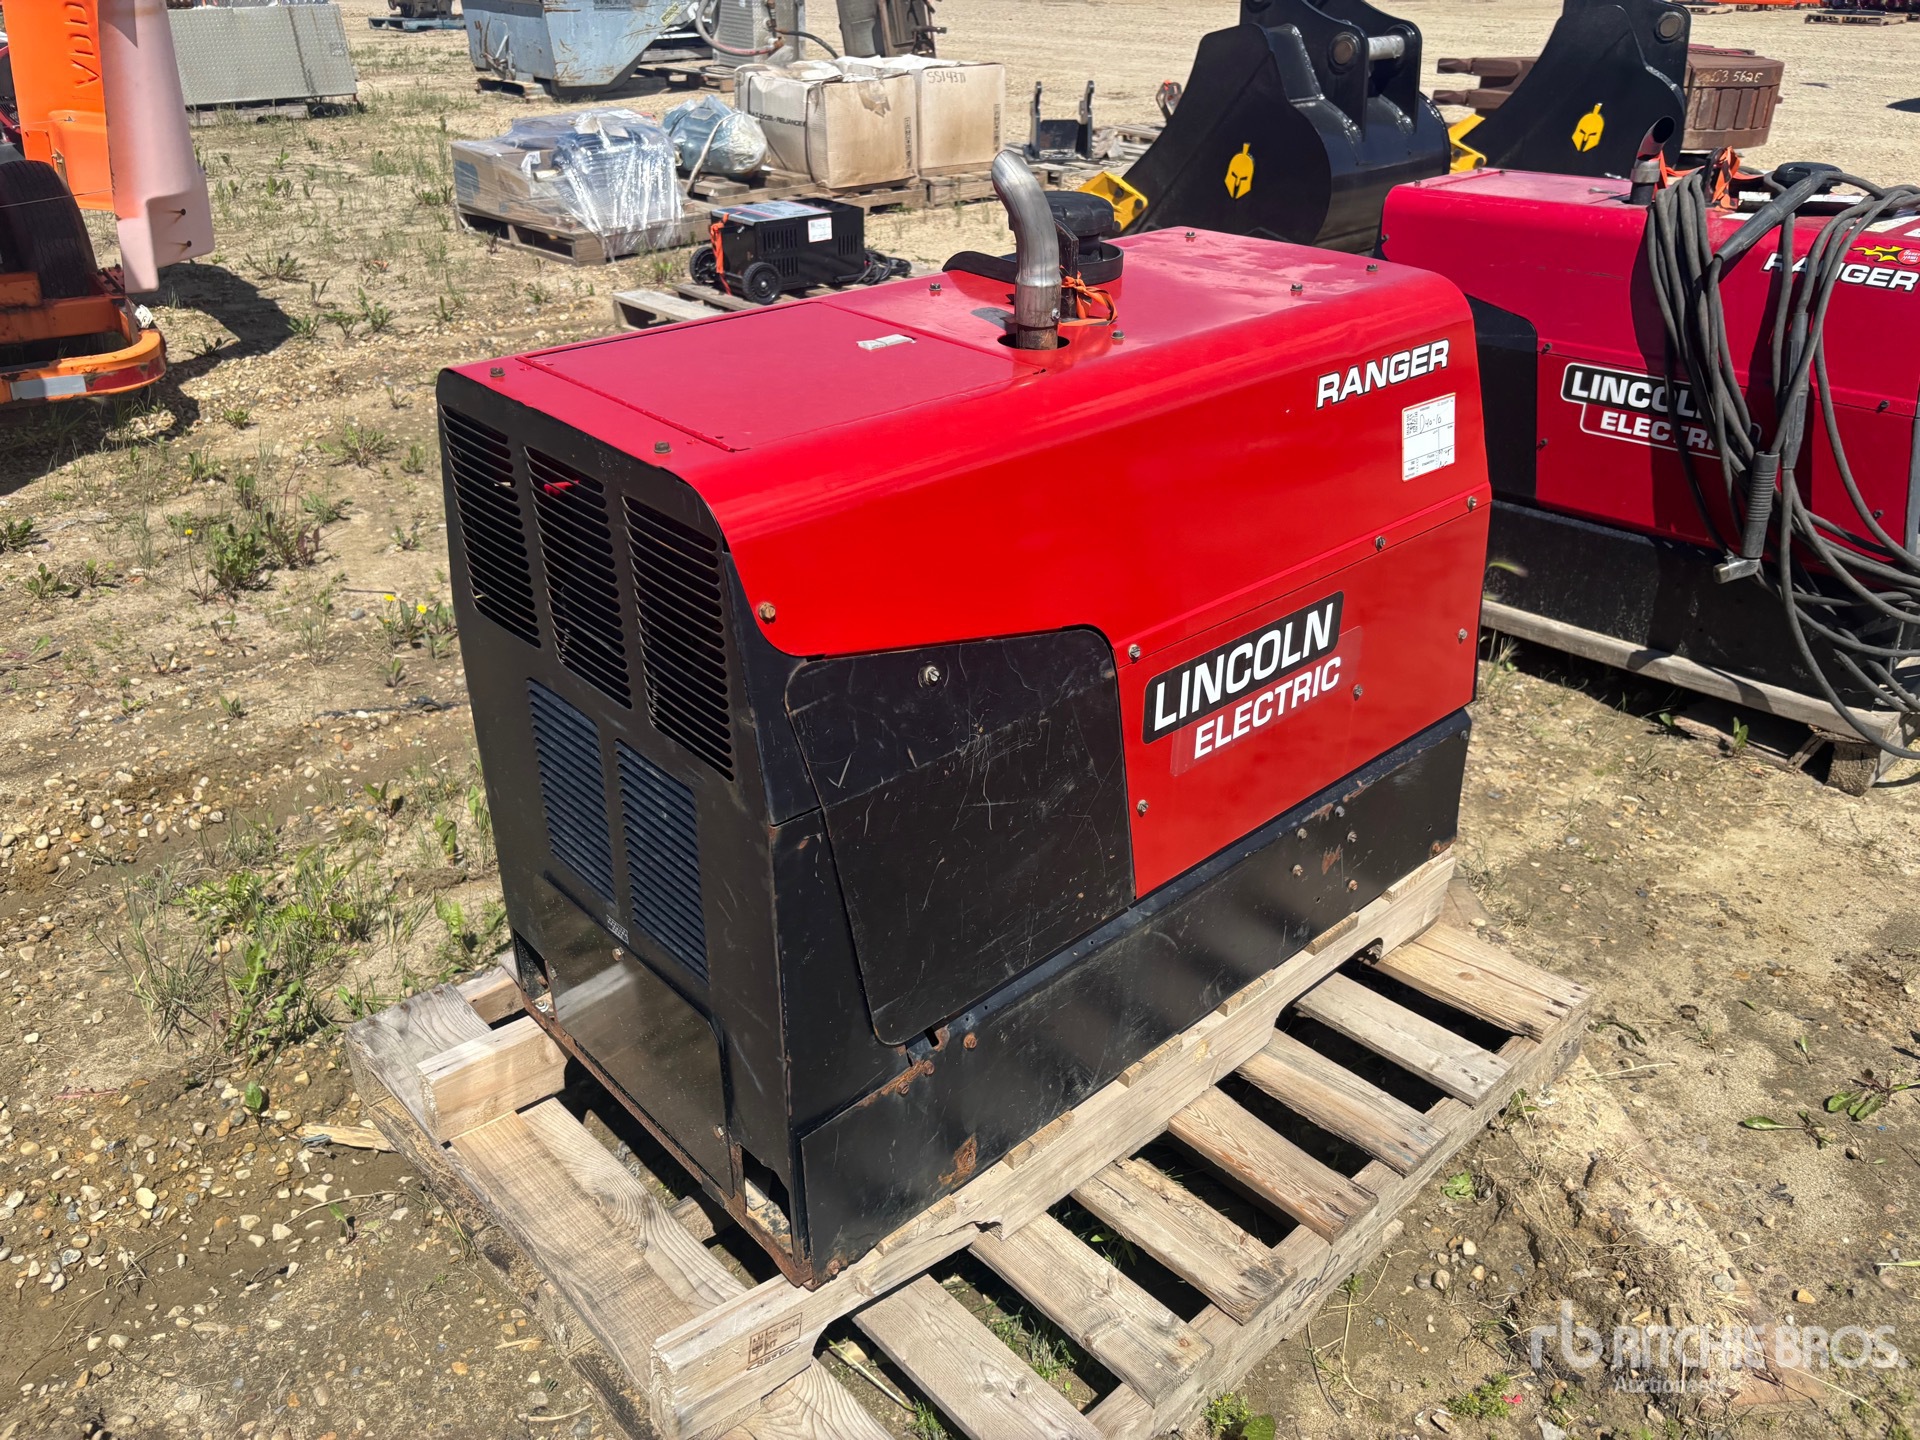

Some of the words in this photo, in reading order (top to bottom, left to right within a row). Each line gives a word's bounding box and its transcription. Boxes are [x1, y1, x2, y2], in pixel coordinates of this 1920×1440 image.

[1315, 338, 1450, 410] RANGER
[1571, 370, 1703, 419] LINCOL
[1153, 602, 1334, 732] LINCOLN
[1193, 656, 1342, 760] ELECTRIC
